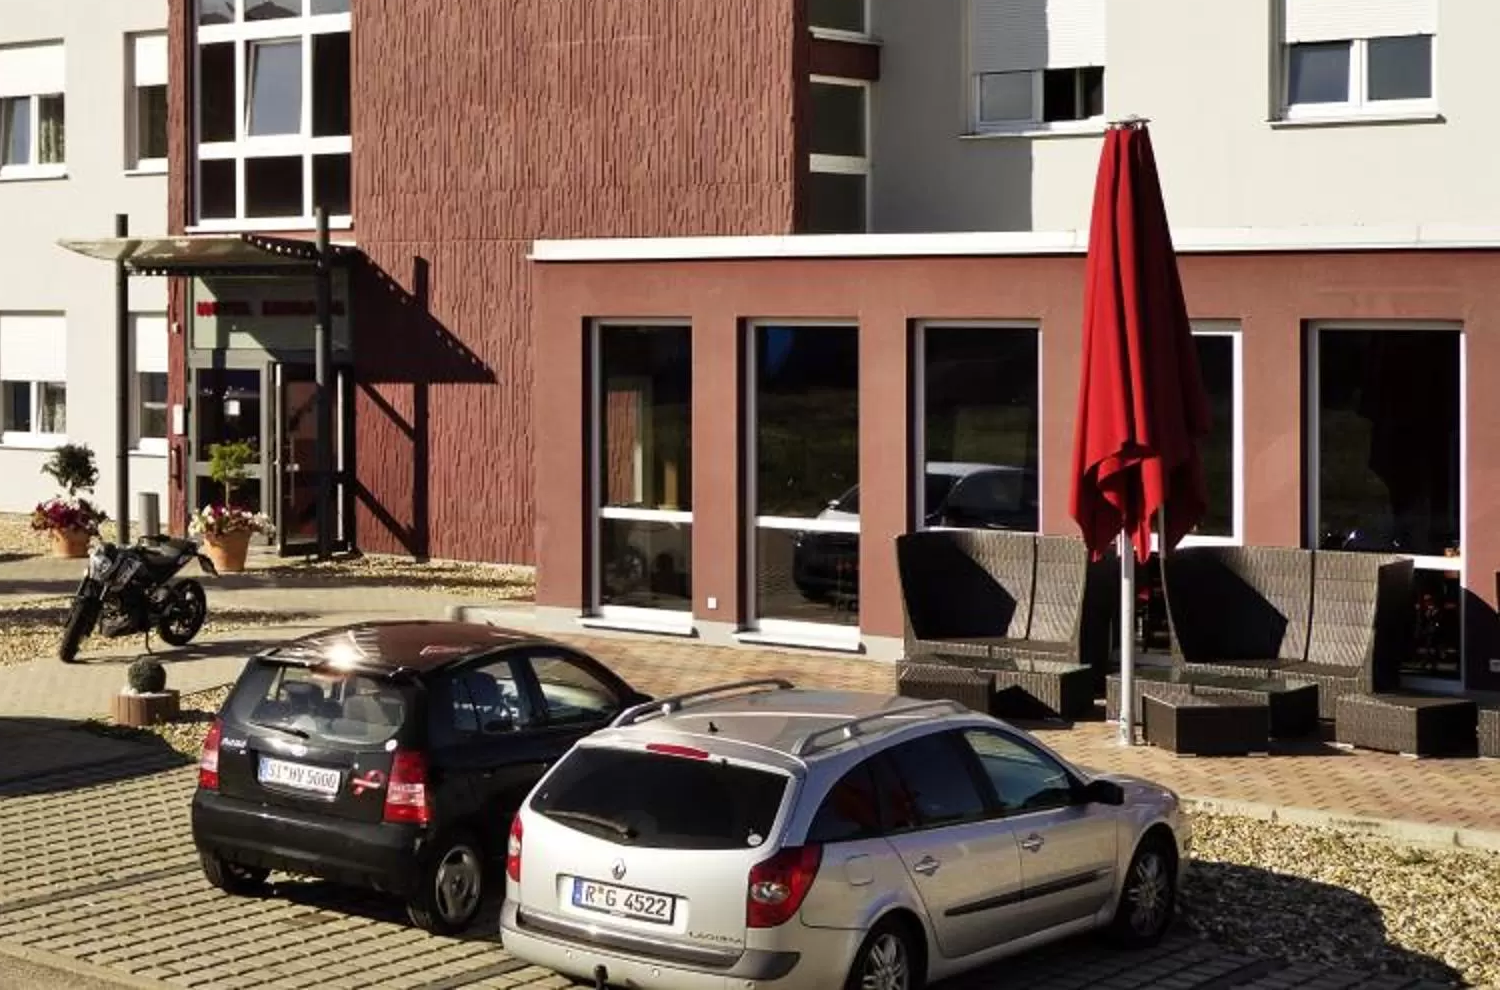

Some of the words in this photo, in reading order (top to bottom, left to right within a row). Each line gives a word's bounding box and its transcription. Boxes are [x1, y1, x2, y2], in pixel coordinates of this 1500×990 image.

[585, 885, 595, 903] R
[605, 889, 617, 907] G
[623, 893, 668, 917] 4522
